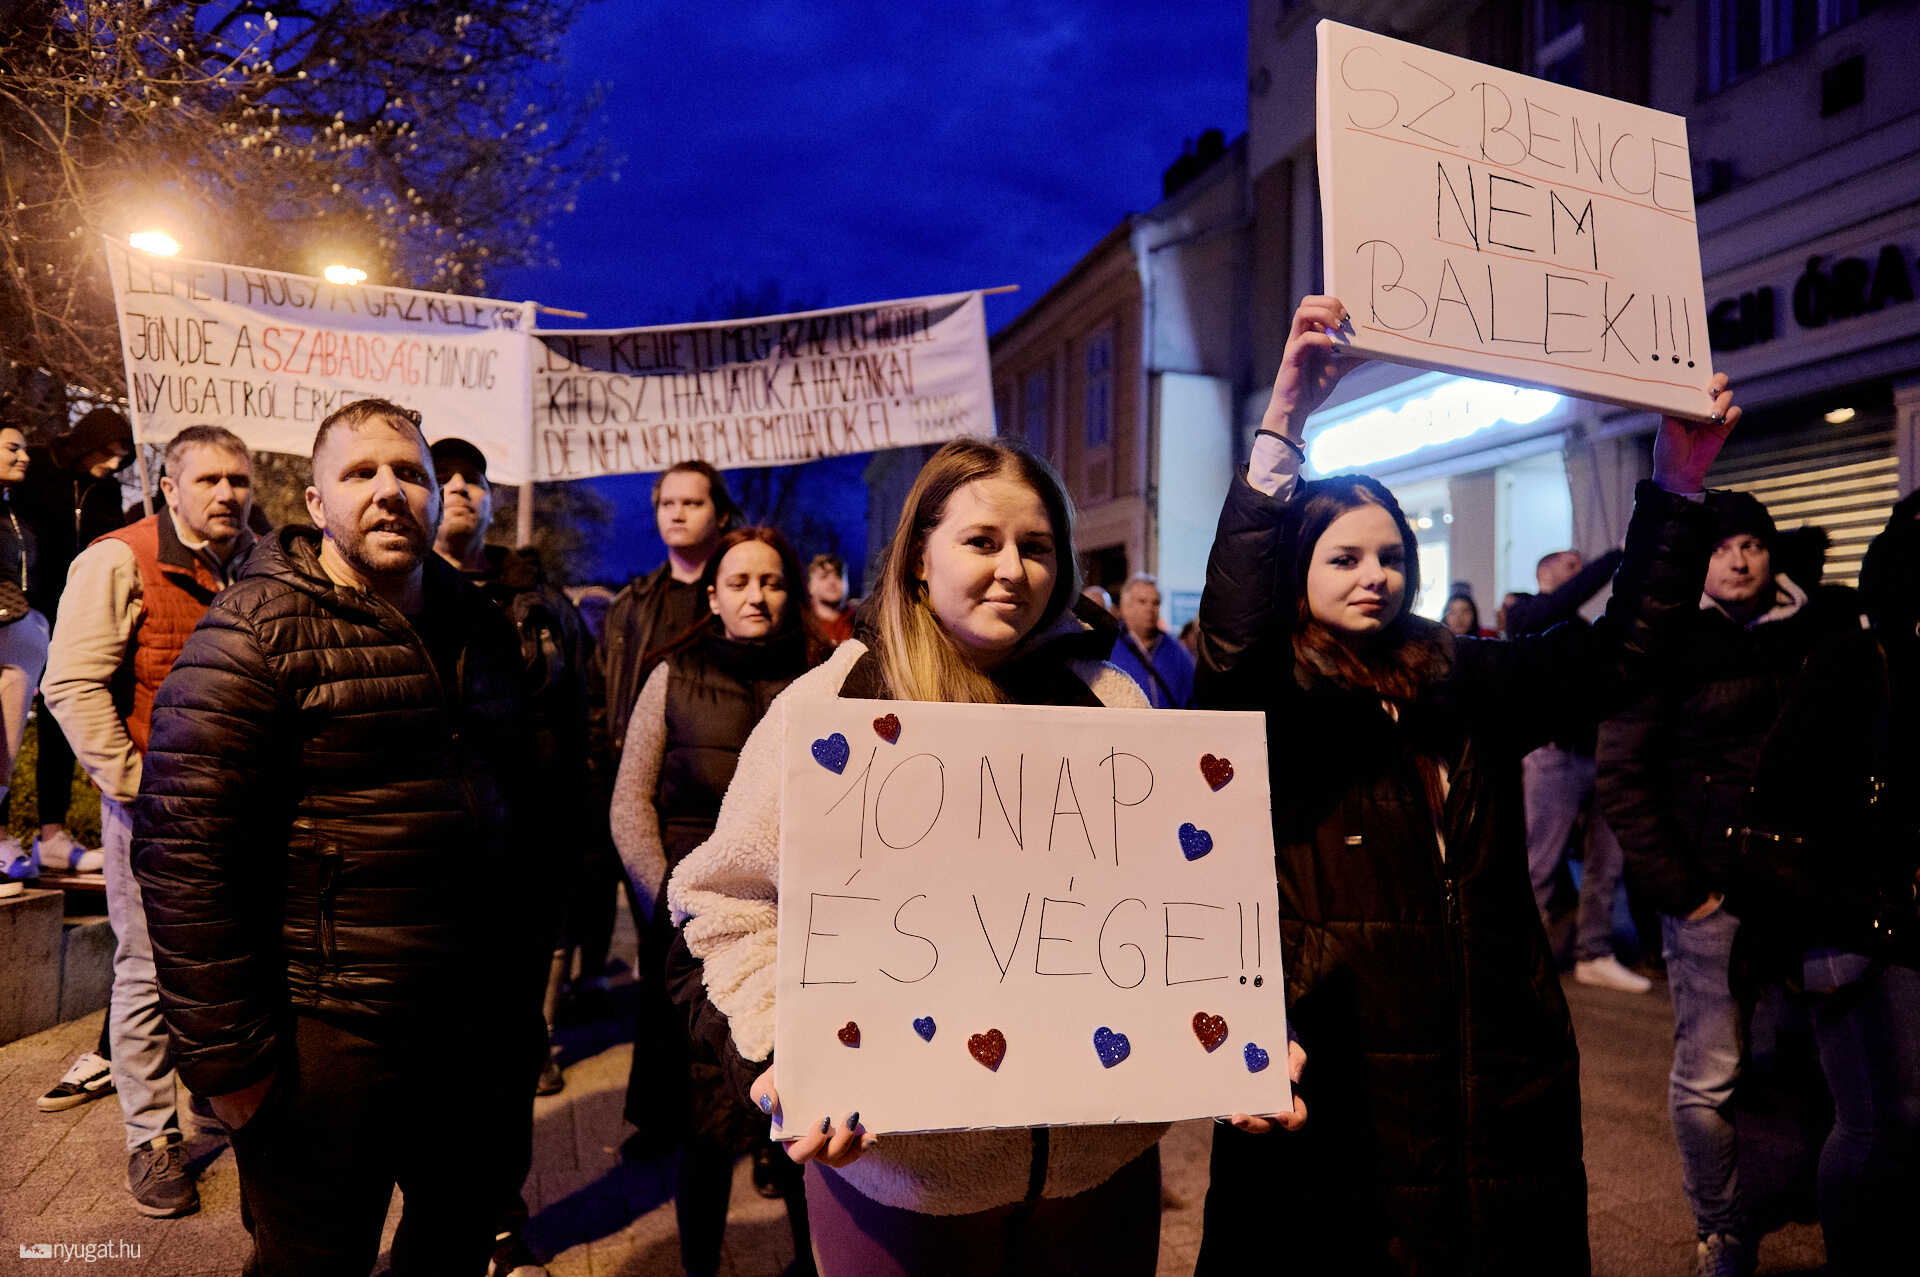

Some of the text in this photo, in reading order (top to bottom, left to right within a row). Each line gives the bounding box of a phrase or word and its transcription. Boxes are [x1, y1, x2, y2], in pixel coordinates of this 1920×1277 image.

[1341, 46, 1691, 213] SZ BENCE
[1433, 161, 1598, 270] NEM
[230, 325, 256, 369] A
[424, 344, 500, 390] MINDIG
[1356, 240, 1696, 368] BALEK!!!
[132, 372, 287, 421] NYUGATRÓL
[544, 428, 580, 476] DE
[825, 746, 1154, 867] 10 NAP
[800, 868, 1264, 990] ÉS VÉGE!!
